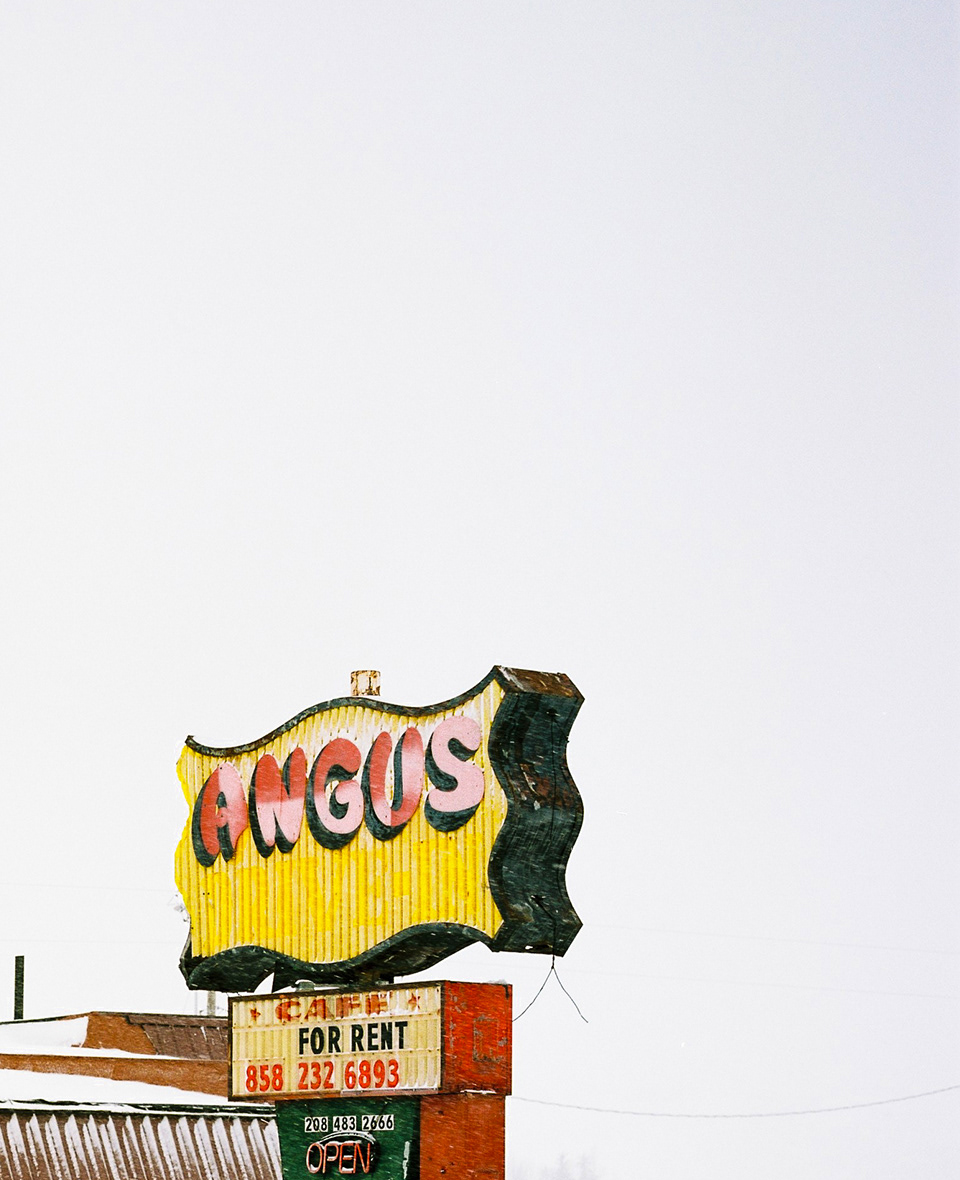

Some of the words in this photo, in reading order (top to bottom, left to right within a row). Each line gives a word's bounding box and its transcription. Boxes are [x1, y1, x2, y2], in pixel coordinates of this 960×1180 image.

[191, 715, 485, 868] ANGUS
[275, 991, 393, 1021] CAFE
[298, 1025, 340, 1055] FOR
[351, 1021, 408, 1052] RENT
[245, 1063, 284, 1092] 858
[298, 1060, 334, 1090] 232
[344, 1058, 400, 1089] 6893
[305, 1117, 328, 1131] 208
[333, 1116, 356, 1131] 483
[362, 1115, 393, 1130] 2666
[305, 1141, 371, 1174] OPEN
